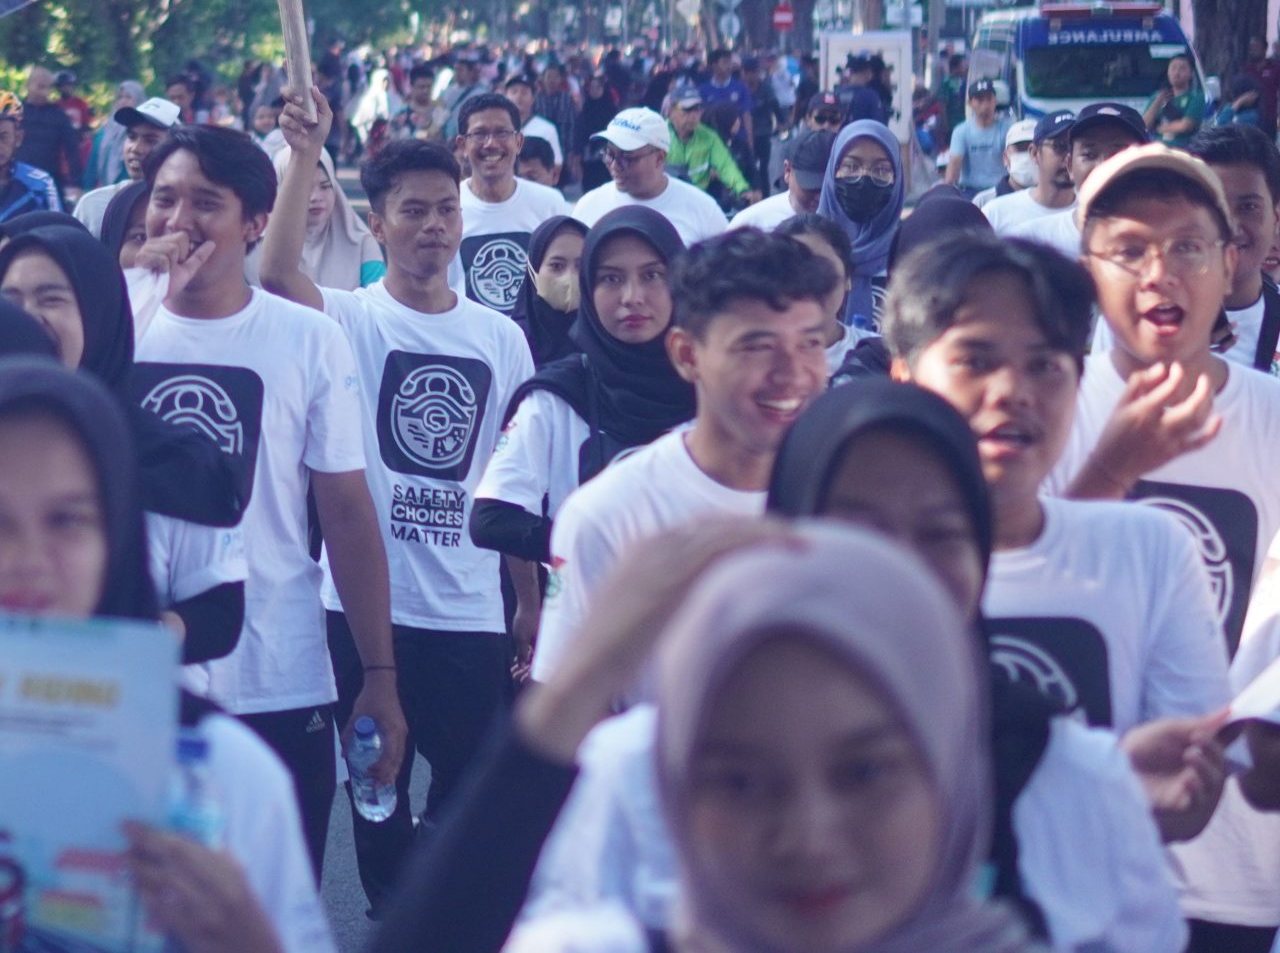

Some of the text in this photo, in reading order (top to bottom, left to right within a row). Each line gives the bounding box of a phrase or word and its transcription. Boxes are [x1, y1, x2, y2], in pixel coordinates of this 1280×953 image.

[393, 484, 467, 508] SAFETY
[392, 503, 463, 527] CHOICES
[390, 523, 461, 548] MATTER
